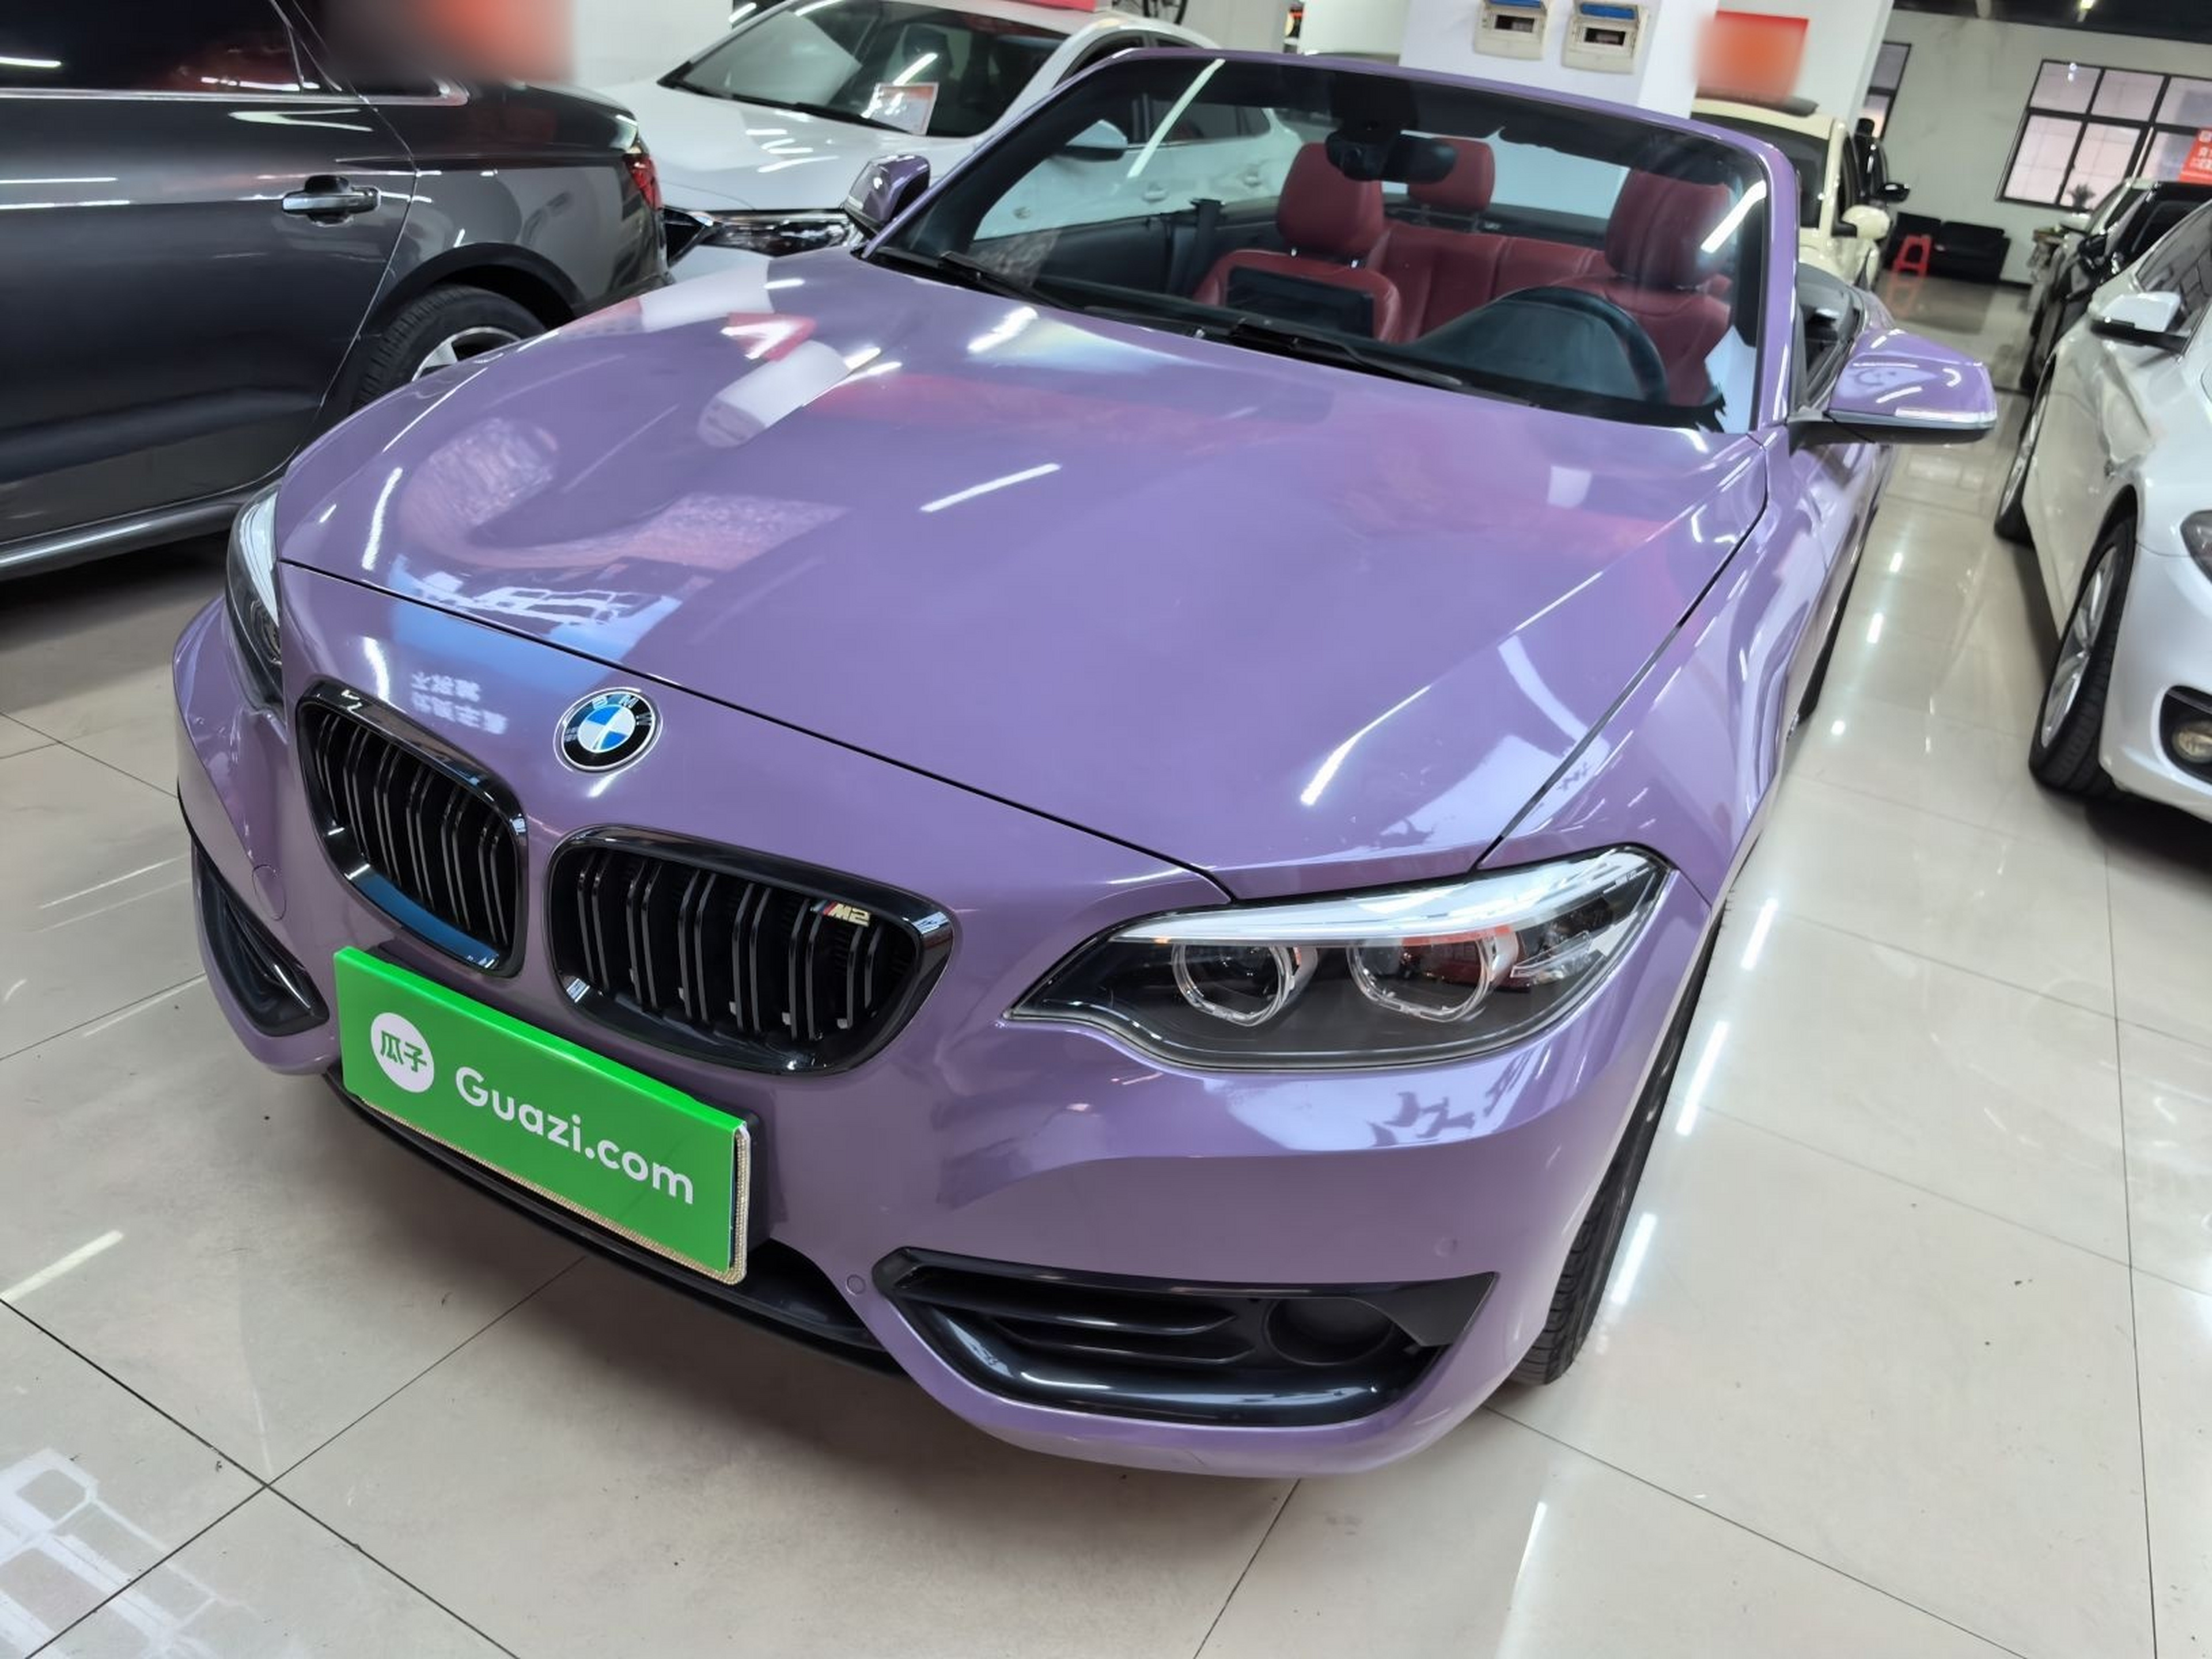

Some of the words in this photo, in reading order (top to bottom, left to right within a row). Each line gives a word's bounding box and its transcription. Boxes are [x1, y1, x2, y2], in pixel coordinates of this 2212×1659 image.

[592, 694, 652, 726] BMW
[827, 903, 871, 927] M2
[380, 1030, 427, 1073] 瓜子
[456, 1067, 693, 1204] Guazi.com
